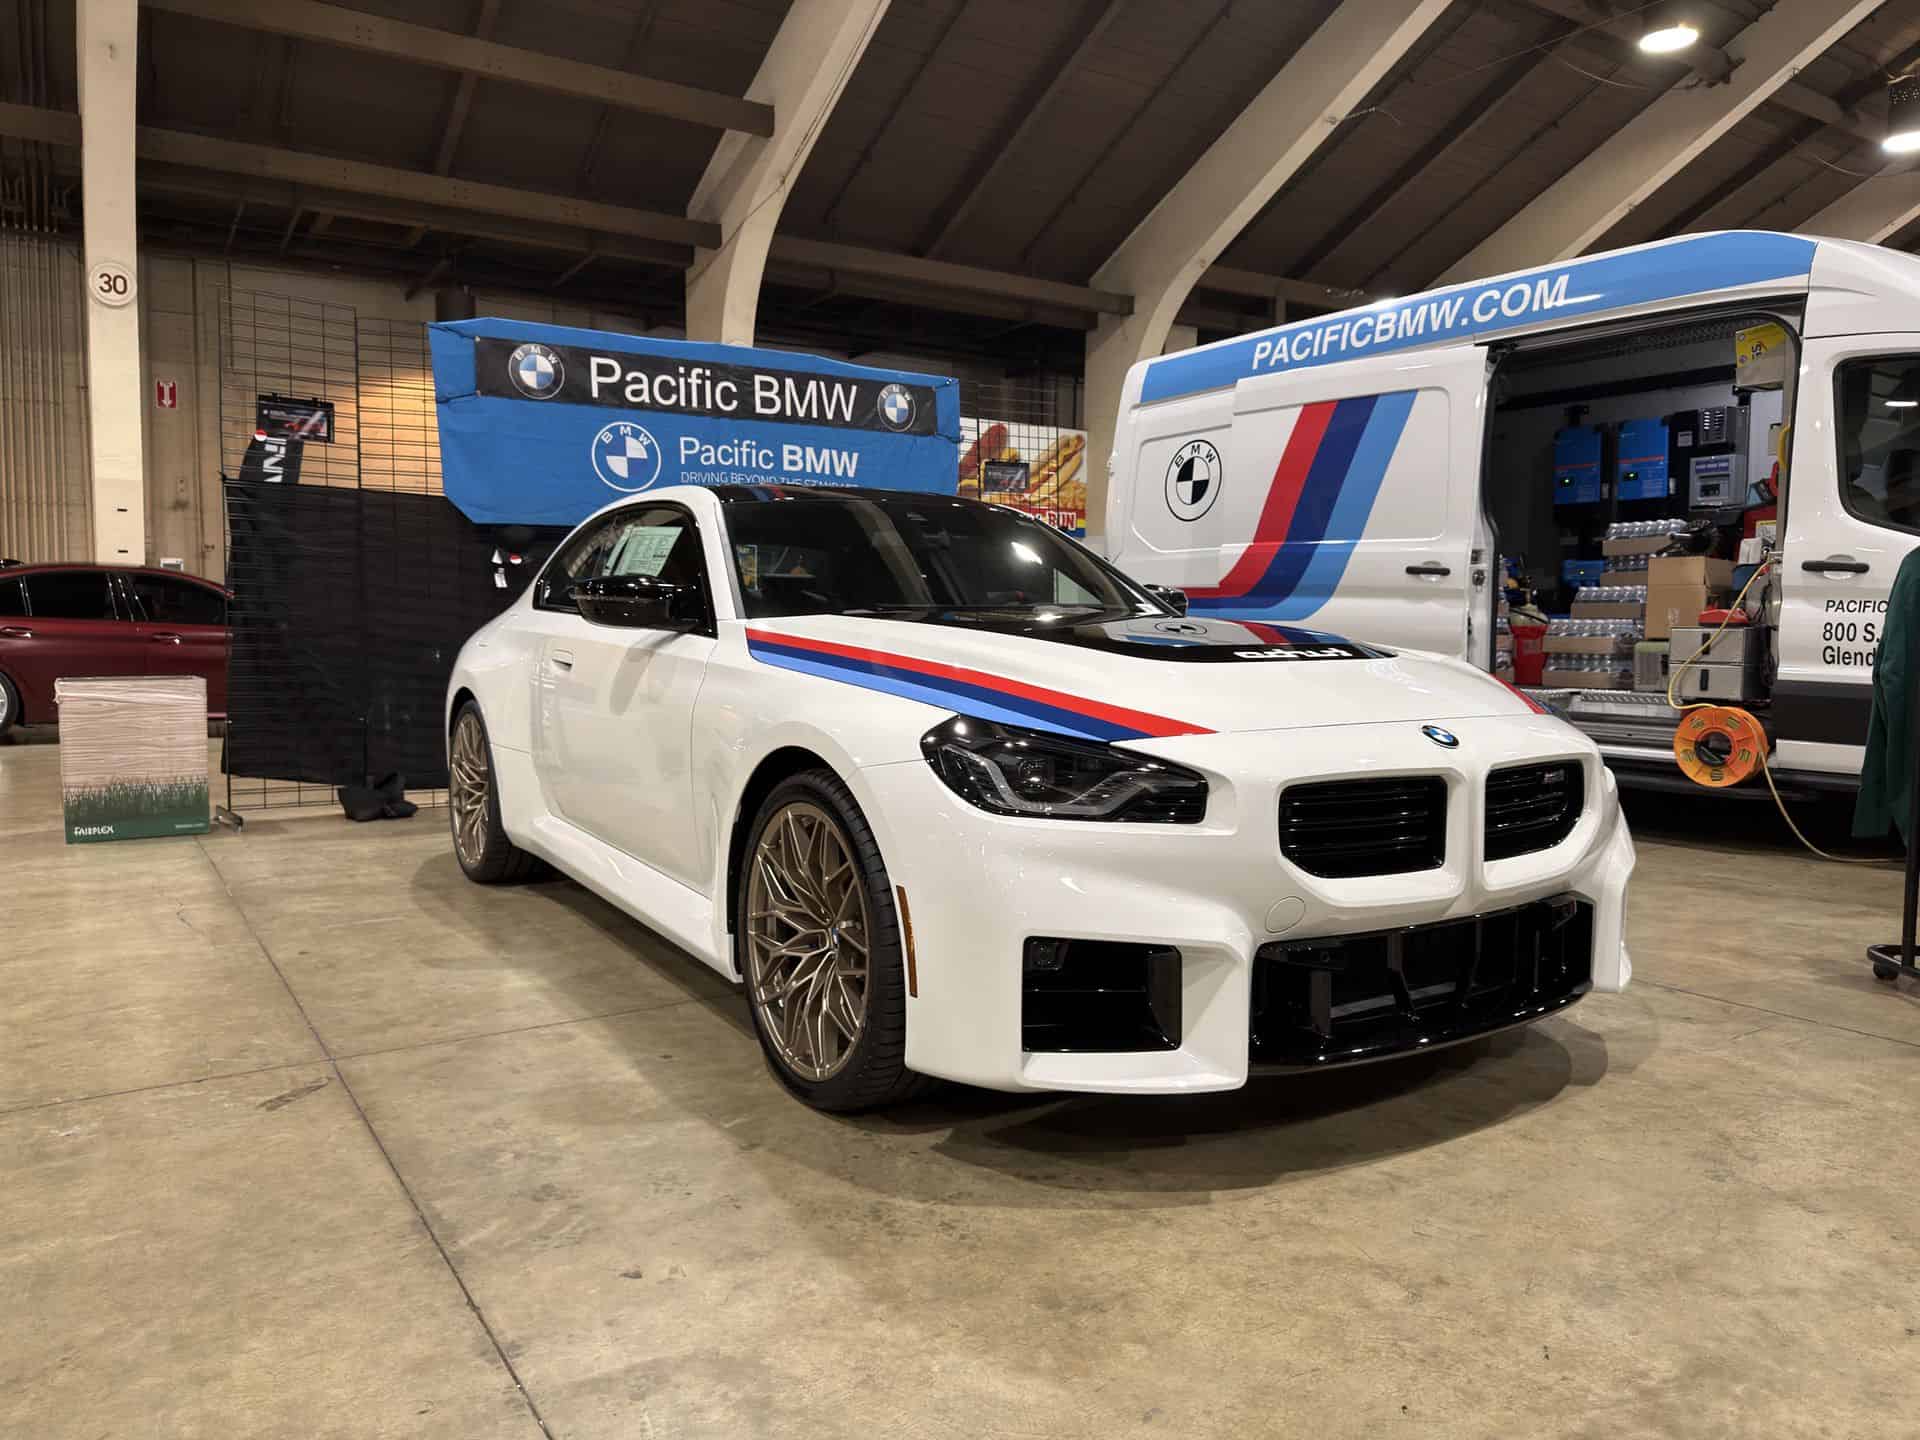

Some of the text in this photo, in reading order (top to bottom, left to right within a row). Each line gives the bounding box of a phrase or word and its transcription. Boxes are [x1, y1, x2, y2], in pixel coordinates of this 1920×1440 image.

[99, 273, 127, 295] 30
[1252, 274, 1570, 370] PACIFICBMW.COM
[590, 356, 857, 422] Pacific BMW
[679, 436, 859, 477] Pacific BMW
[680, 471, 728, 484] DRIVING
[1823, 622, 1880, 643] 800 S.
